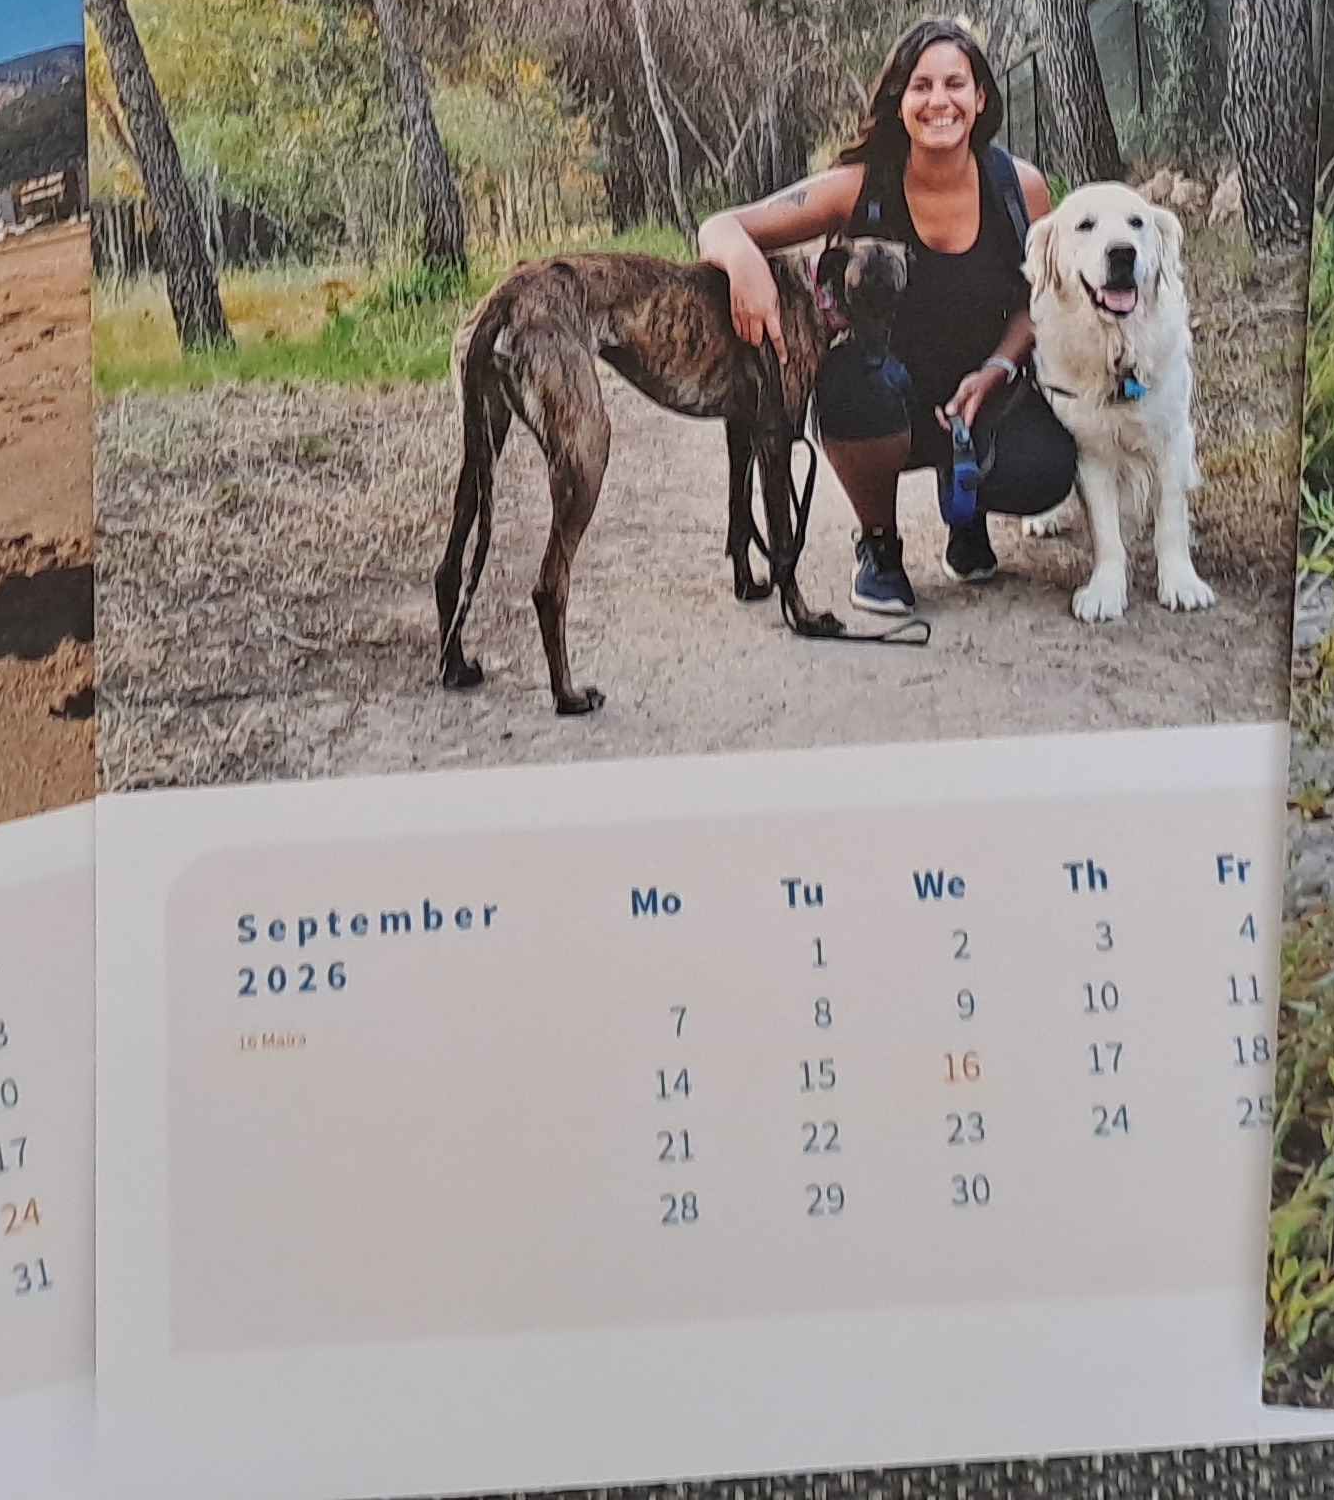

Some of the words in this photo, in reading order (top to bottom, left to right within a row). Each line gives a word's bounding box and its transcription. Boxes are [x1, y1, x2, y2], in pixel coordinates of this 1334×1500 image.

[632, 887, 681, 917] Mo
[781, 878, 823, 908] Tu
[913, 871, 965, 899] We
[1063, 860, 1107, 891] Th
[1217, 855, 1250, 884] Fr
[238, 899, 497, 947] September
[239, 962, 346, 996] 2026
[1085, 981, 1119, 1013] 10
[1230, 974, 1264, 1004] 11
[655, 1068, 690, 1100] 14
[800, 1058, 836, 1090] 15
[945, 1051, 981, 1082] 16
[1089, 1042, 1123, 1074] 17
[1236, 1034, 1274, 1066] 18
[658, 1129, 690, 1162] 21
[802, 1121, 840, 1153] 22
[946, 1111, 985, 1144] 23
[1092, 1104, 1129, 1136] 24
[2, 1197, 40, 1236] 24
[660, 1191, 699, 1225] 28
[806, 1183, 845, 1216] 29
[952, 1175, 990, 1205] 30
[13, 1257, 52, 1294] 31
